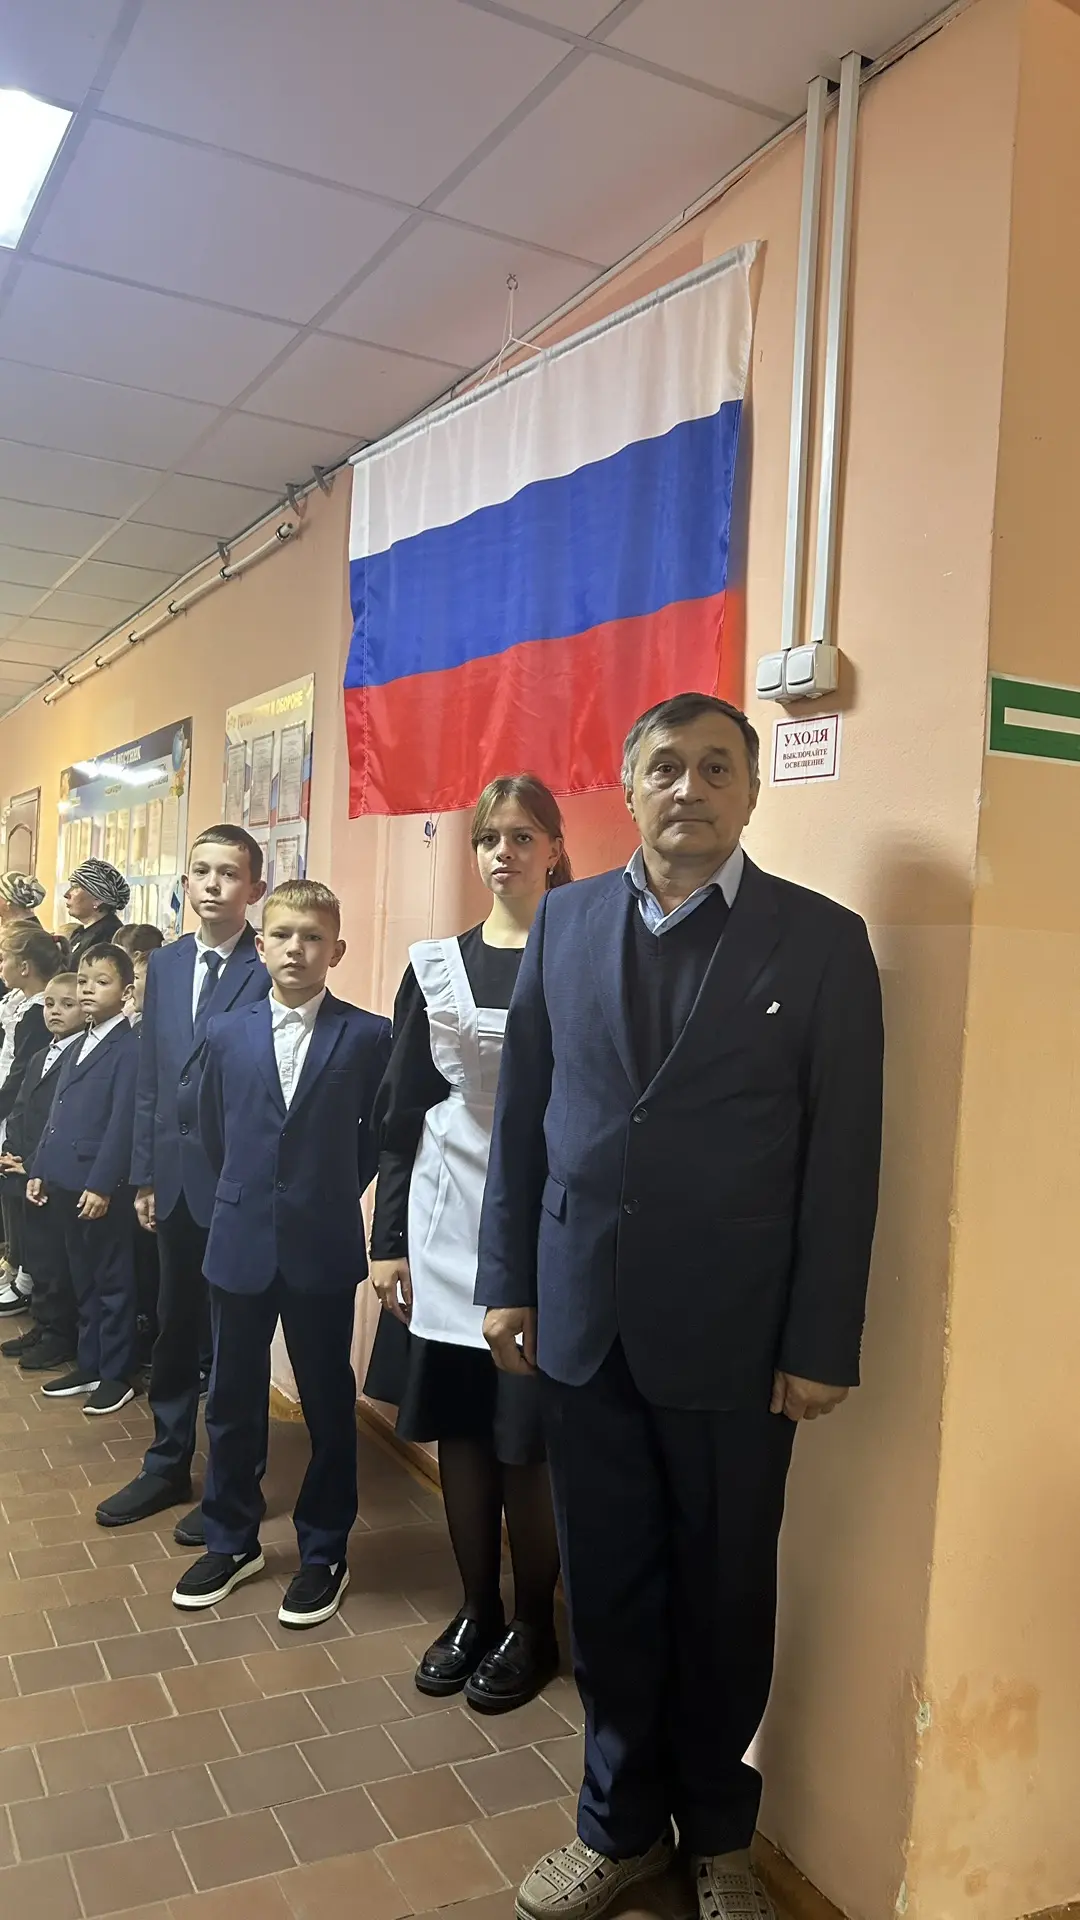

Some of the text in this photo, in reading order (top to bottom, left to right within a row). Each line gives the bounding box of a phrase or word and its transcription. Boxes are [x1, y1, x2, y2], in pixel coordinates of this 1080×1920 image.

[784, 728, 829, 747] УХОДЯ
[782, 748, 828, 760] ВЫКЛЮЧАЙТЕ
[784, 758, 825, 769] ОСВЕЩЕНИЕ
